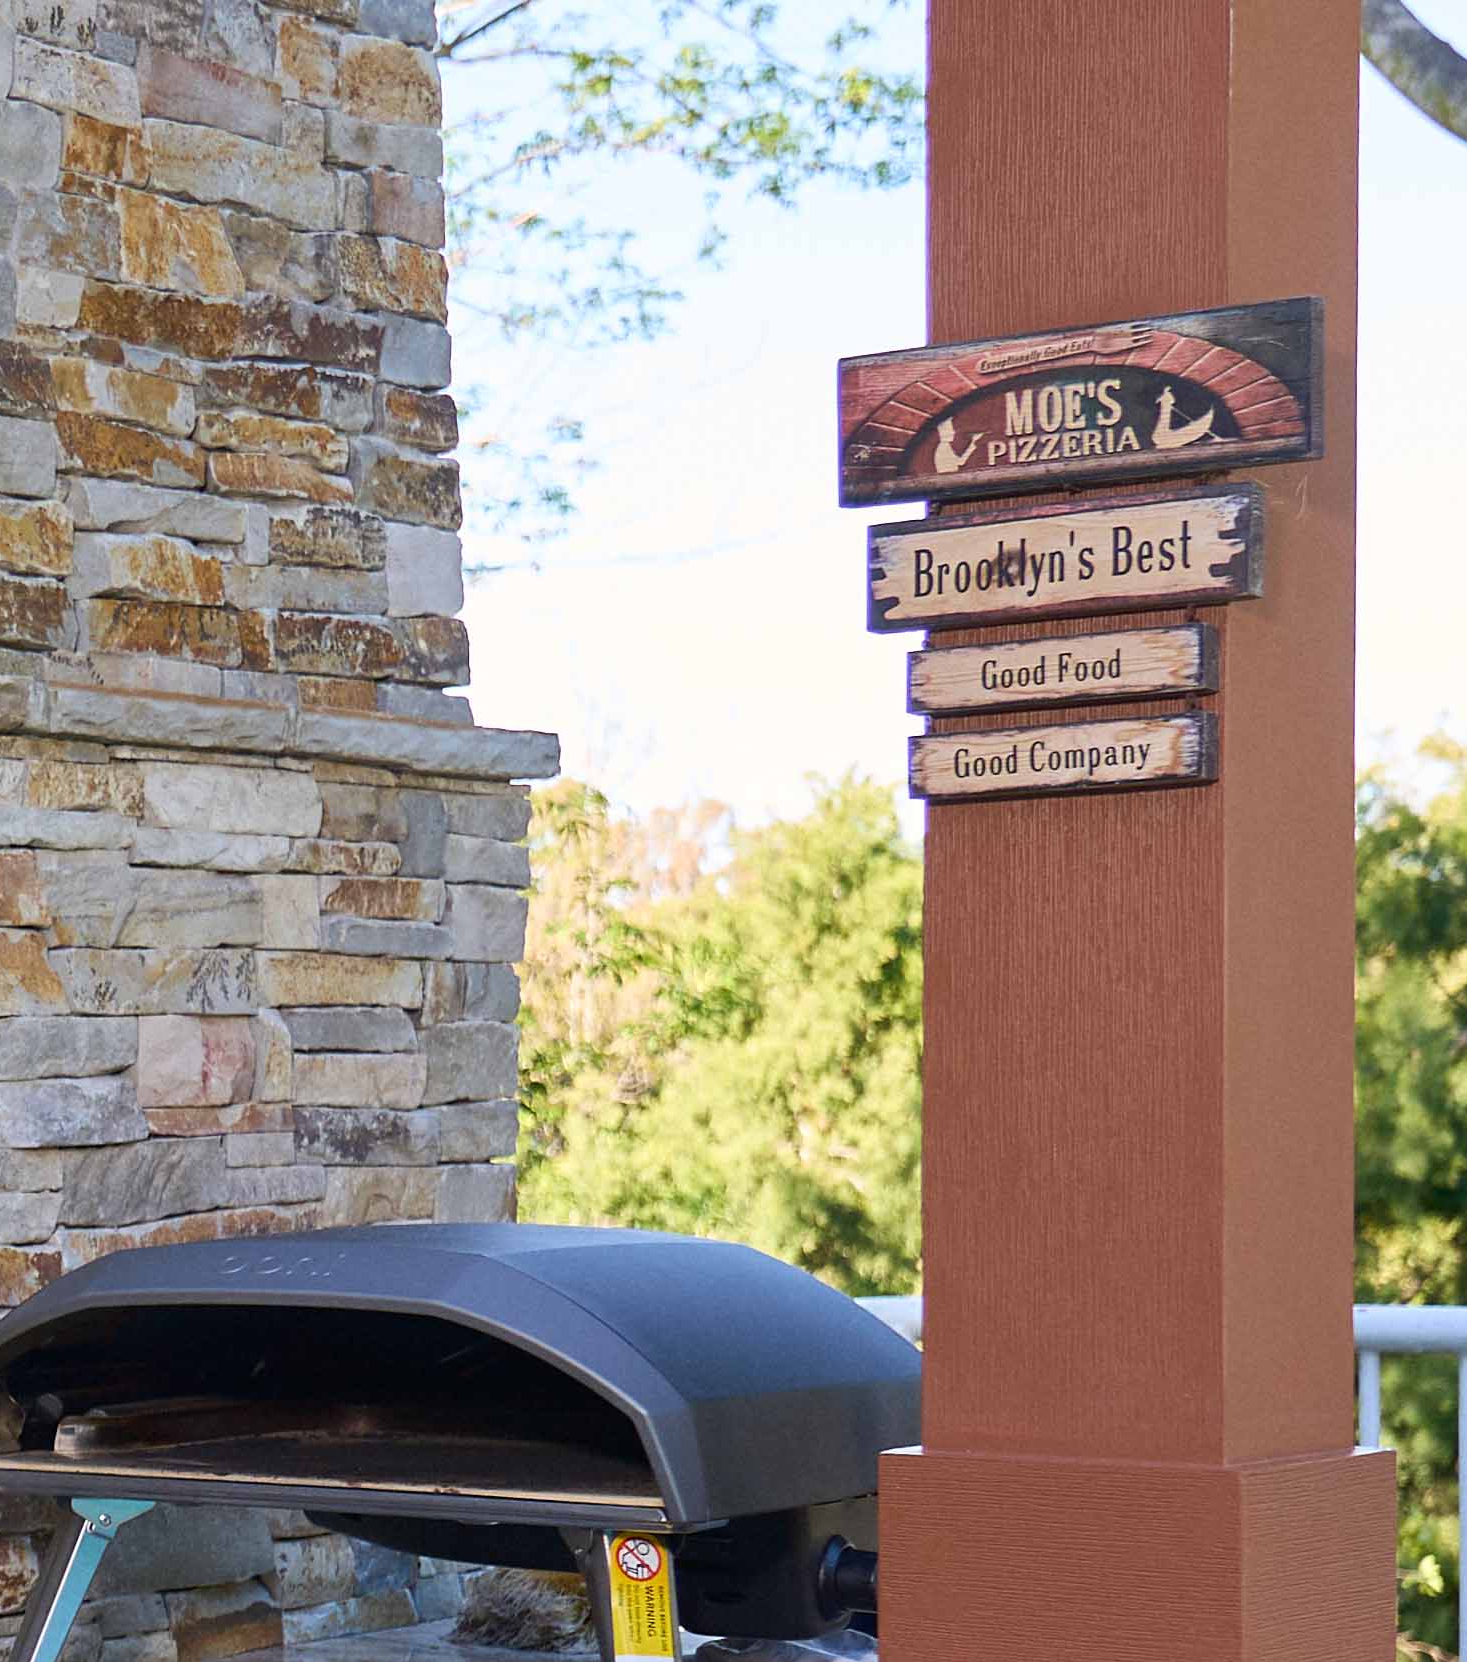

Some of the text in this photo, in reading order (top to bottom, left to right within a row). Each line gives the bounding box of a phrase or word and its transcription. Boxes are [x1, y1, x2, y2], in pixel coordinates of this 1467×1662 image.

[1005, 379, 1122, 437] MOE'S
[988, 425, 1141, 466] PIZZERIA
[913, 519, 1193, 598] Brooklyn's Best
[982, 648, 1121, 690] Good Food
[954, 740, 1151, 778] Good Company
[644, 1585, 658, 1637] WARNING
